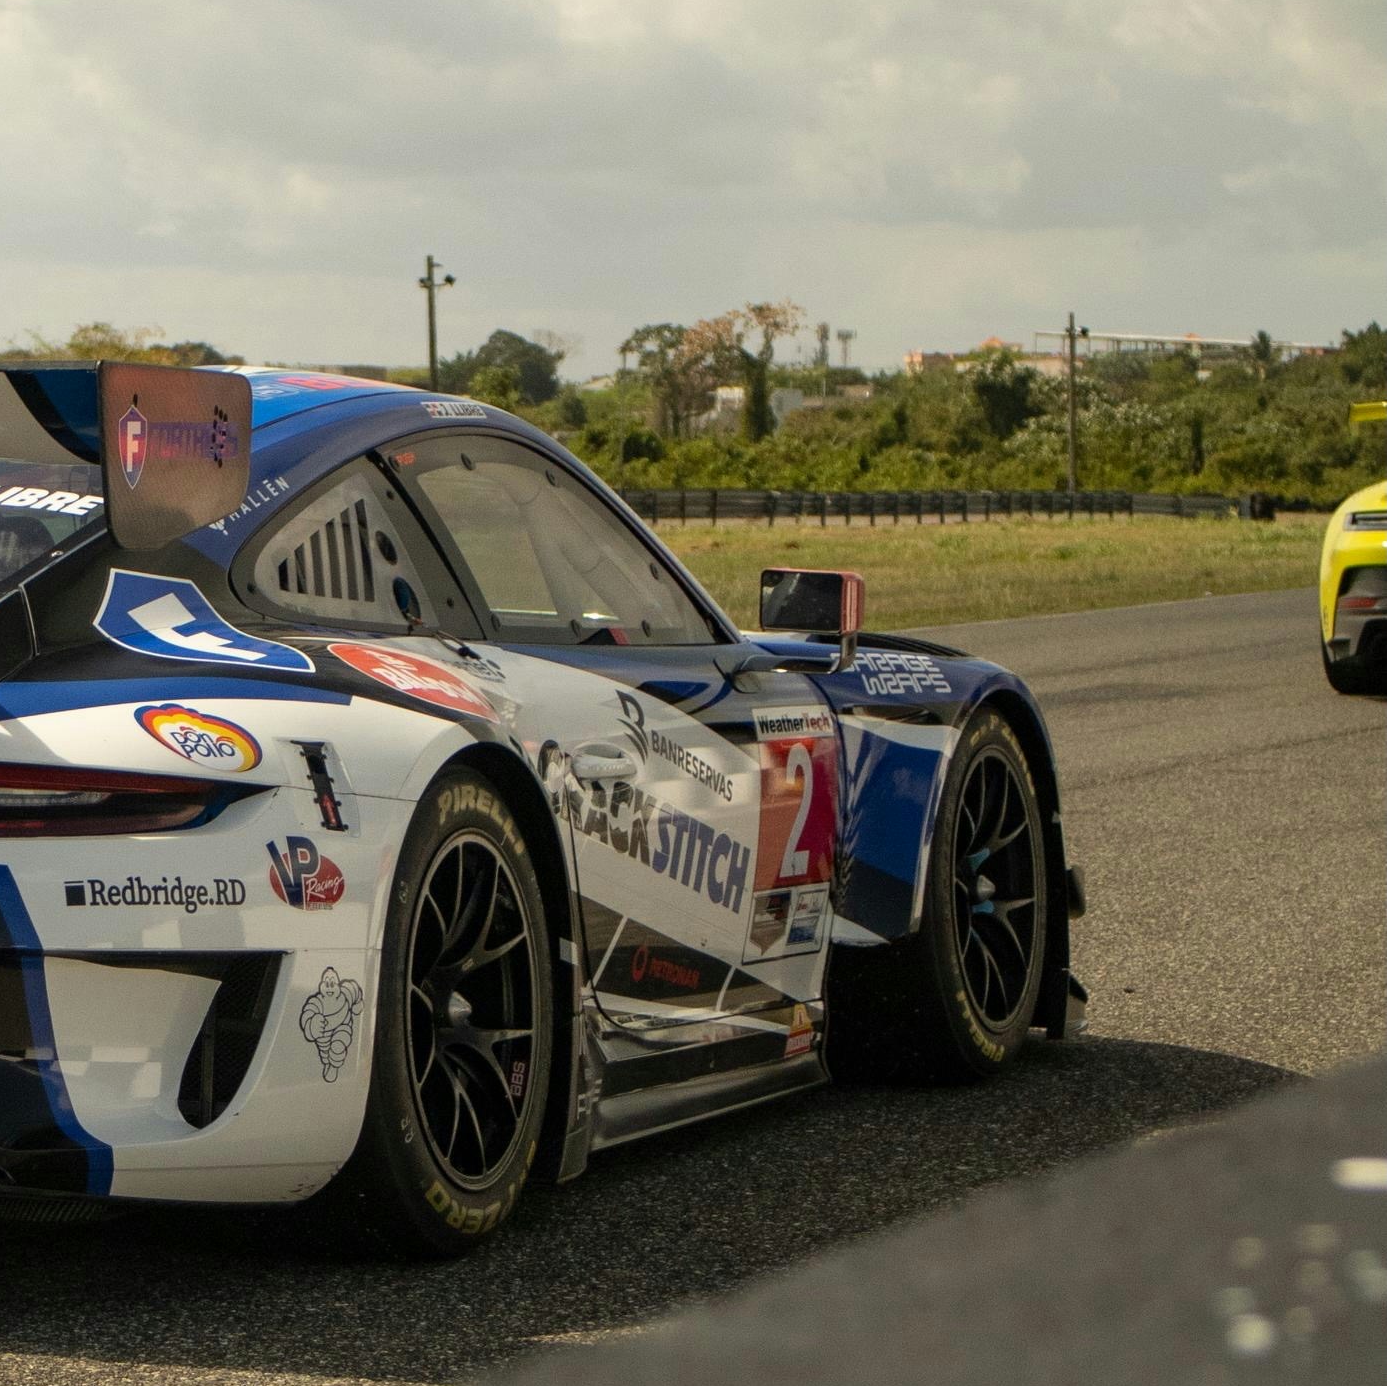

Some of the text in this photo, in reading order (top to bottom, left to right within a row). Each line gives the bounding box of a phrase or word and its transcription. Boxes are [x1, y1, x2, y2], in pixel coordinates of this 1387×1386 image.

[861, 672, 953, 696] WRAPS
[757, 712, 831, 735] WeatherTech
[650, 729, 734, 803] BANRESERVAS
[778, 742, 814, 878] 2
[265, 834, 320, 910] VP
[651, 801, 751, 914] STITCH
[87, 876, 247, 914] Redbridge.RD
[305, 876, 344, 902] Racing
[510, 1060, 526, 1097] BBS
